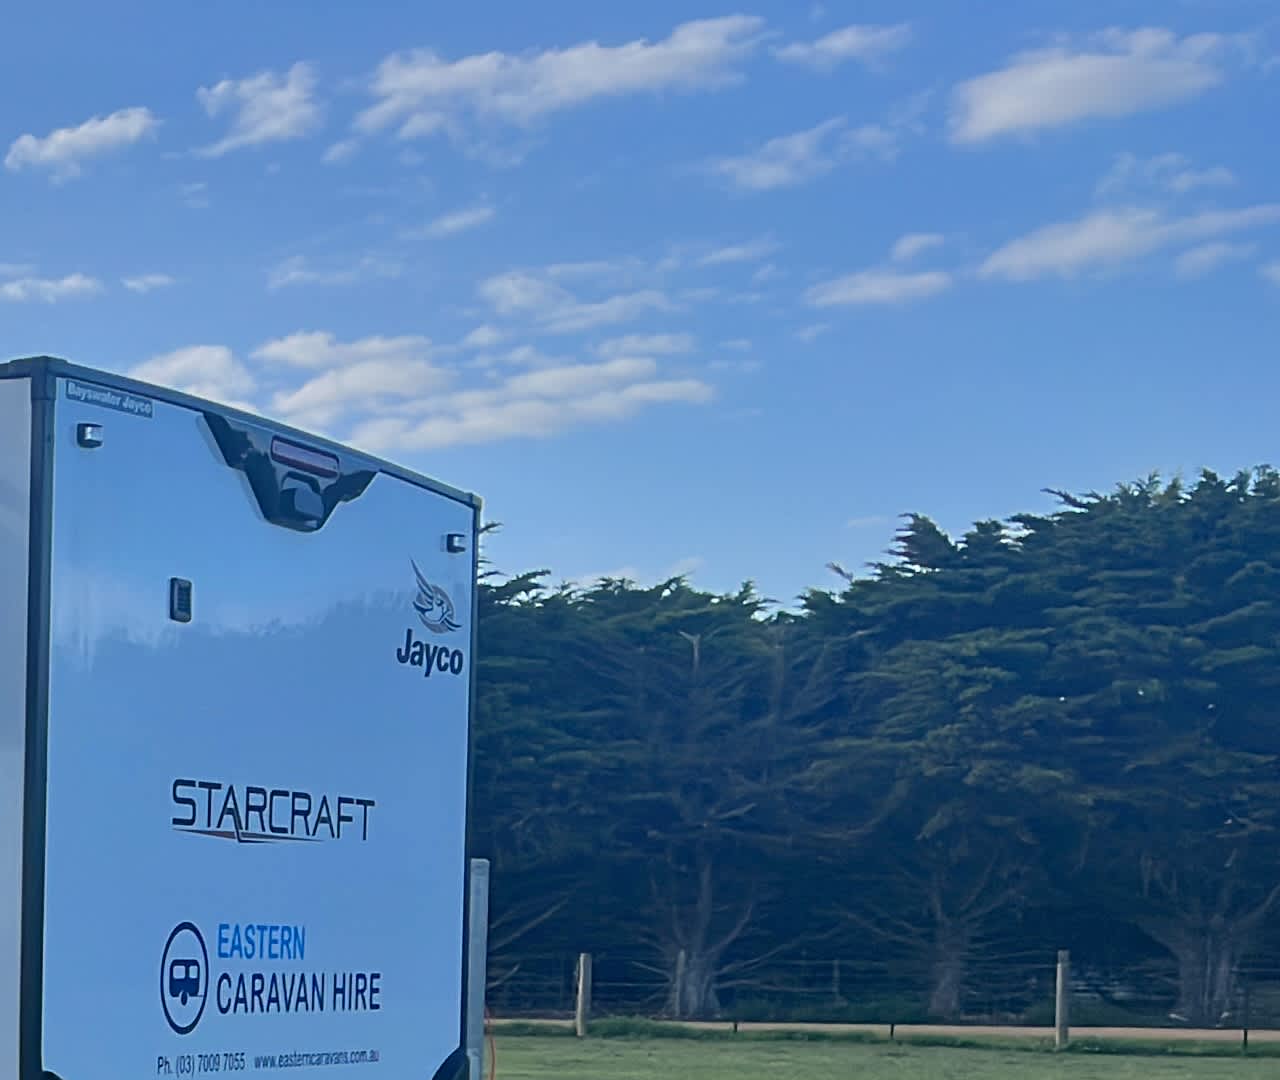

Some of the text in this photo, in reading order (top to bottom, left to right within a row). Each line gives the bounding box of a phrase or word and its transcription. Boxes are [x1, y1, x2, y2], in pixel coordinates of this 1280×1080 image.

[122, 396, 152, 414] Jayco
[396, 628, 464, 678] Jayco
[171, 778, 376, 842] STARCRAFT
[216, 923, 306, 960] EASTERN
[216, 972, 381, 1014] CARAVAN HIRE
[157, 1048, 380, 1078] Ph. (03) 7009 7055 www.easterncaravans.com.au
